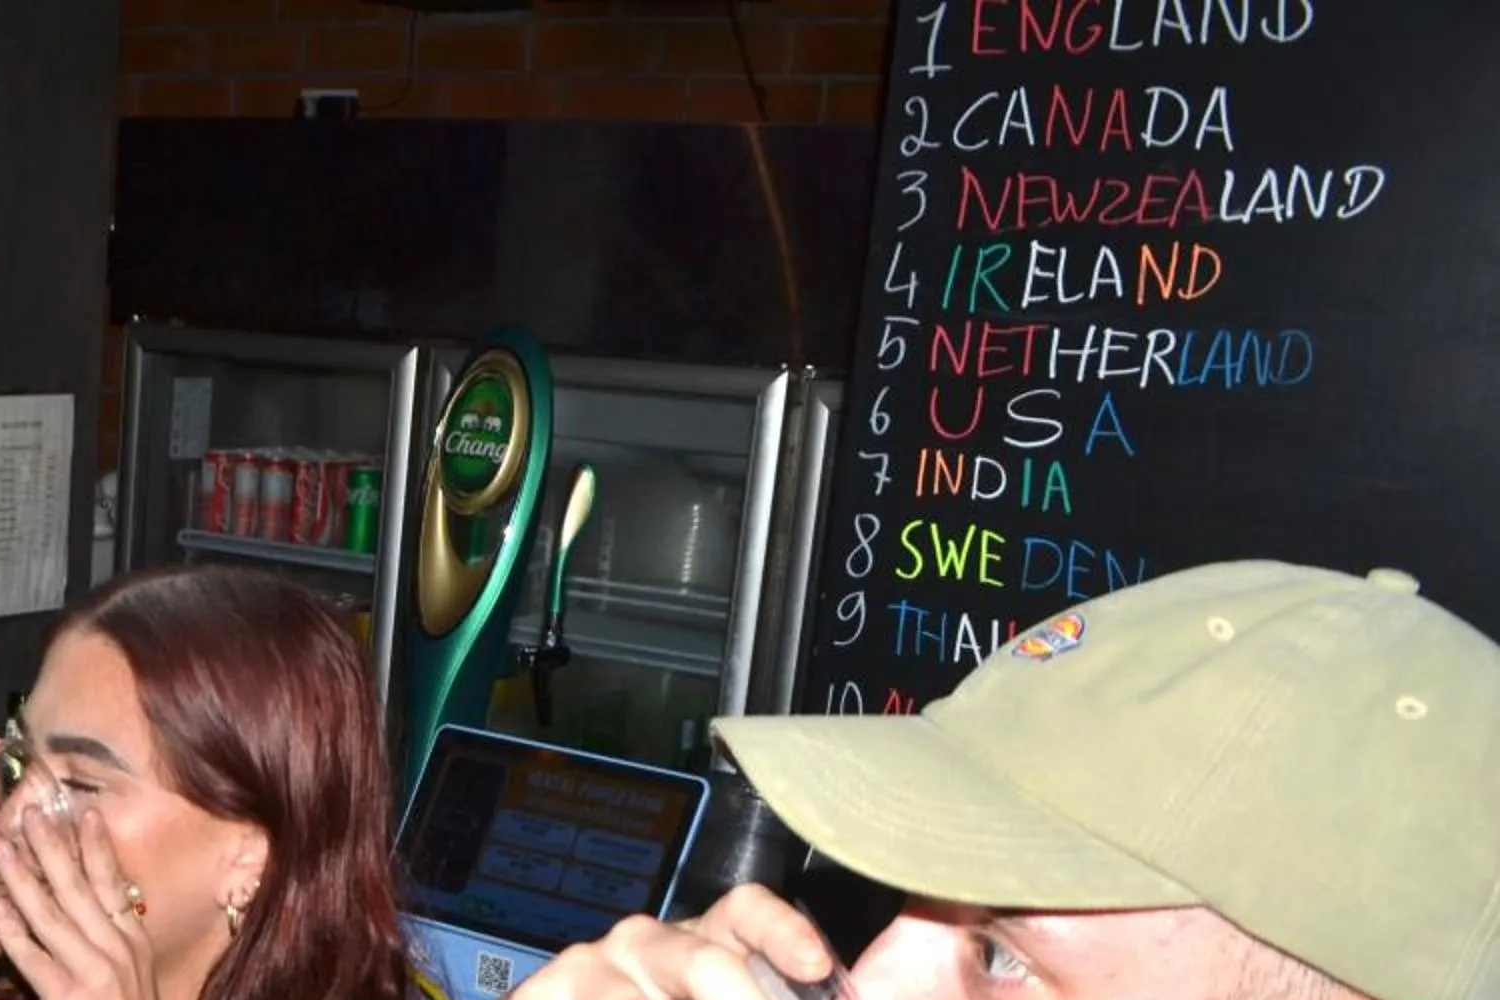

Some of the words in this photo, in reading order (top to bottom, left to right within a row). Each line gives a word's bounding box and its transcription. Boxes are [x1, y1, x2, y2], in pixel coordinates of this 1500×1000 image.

[909, 1, 952, 79] 1
[972, 0, 1314, 54] ENGLAND
[900, 96, 940, 157] 2
[953, 86, 1234, 152] CANADA
[897, 170, 928, 231] 3
[884, 242, 919, 309] 4
[942, 240, 1221, 313] IRELAND
[877, 316, 920, 369] 5
[930, 321, 1312, 389] NETHERLAND
[869, 390, 890, 435] 6
[445, 430, 510, 464] Chang
[858, 451, 892, 496] 7
[916, 447, 1071, 513] INDIA
[846, 513, 881, 578] 8
[895, 520, 1146, 599] SWEDEN
[833, 591, 866, 646] 9
